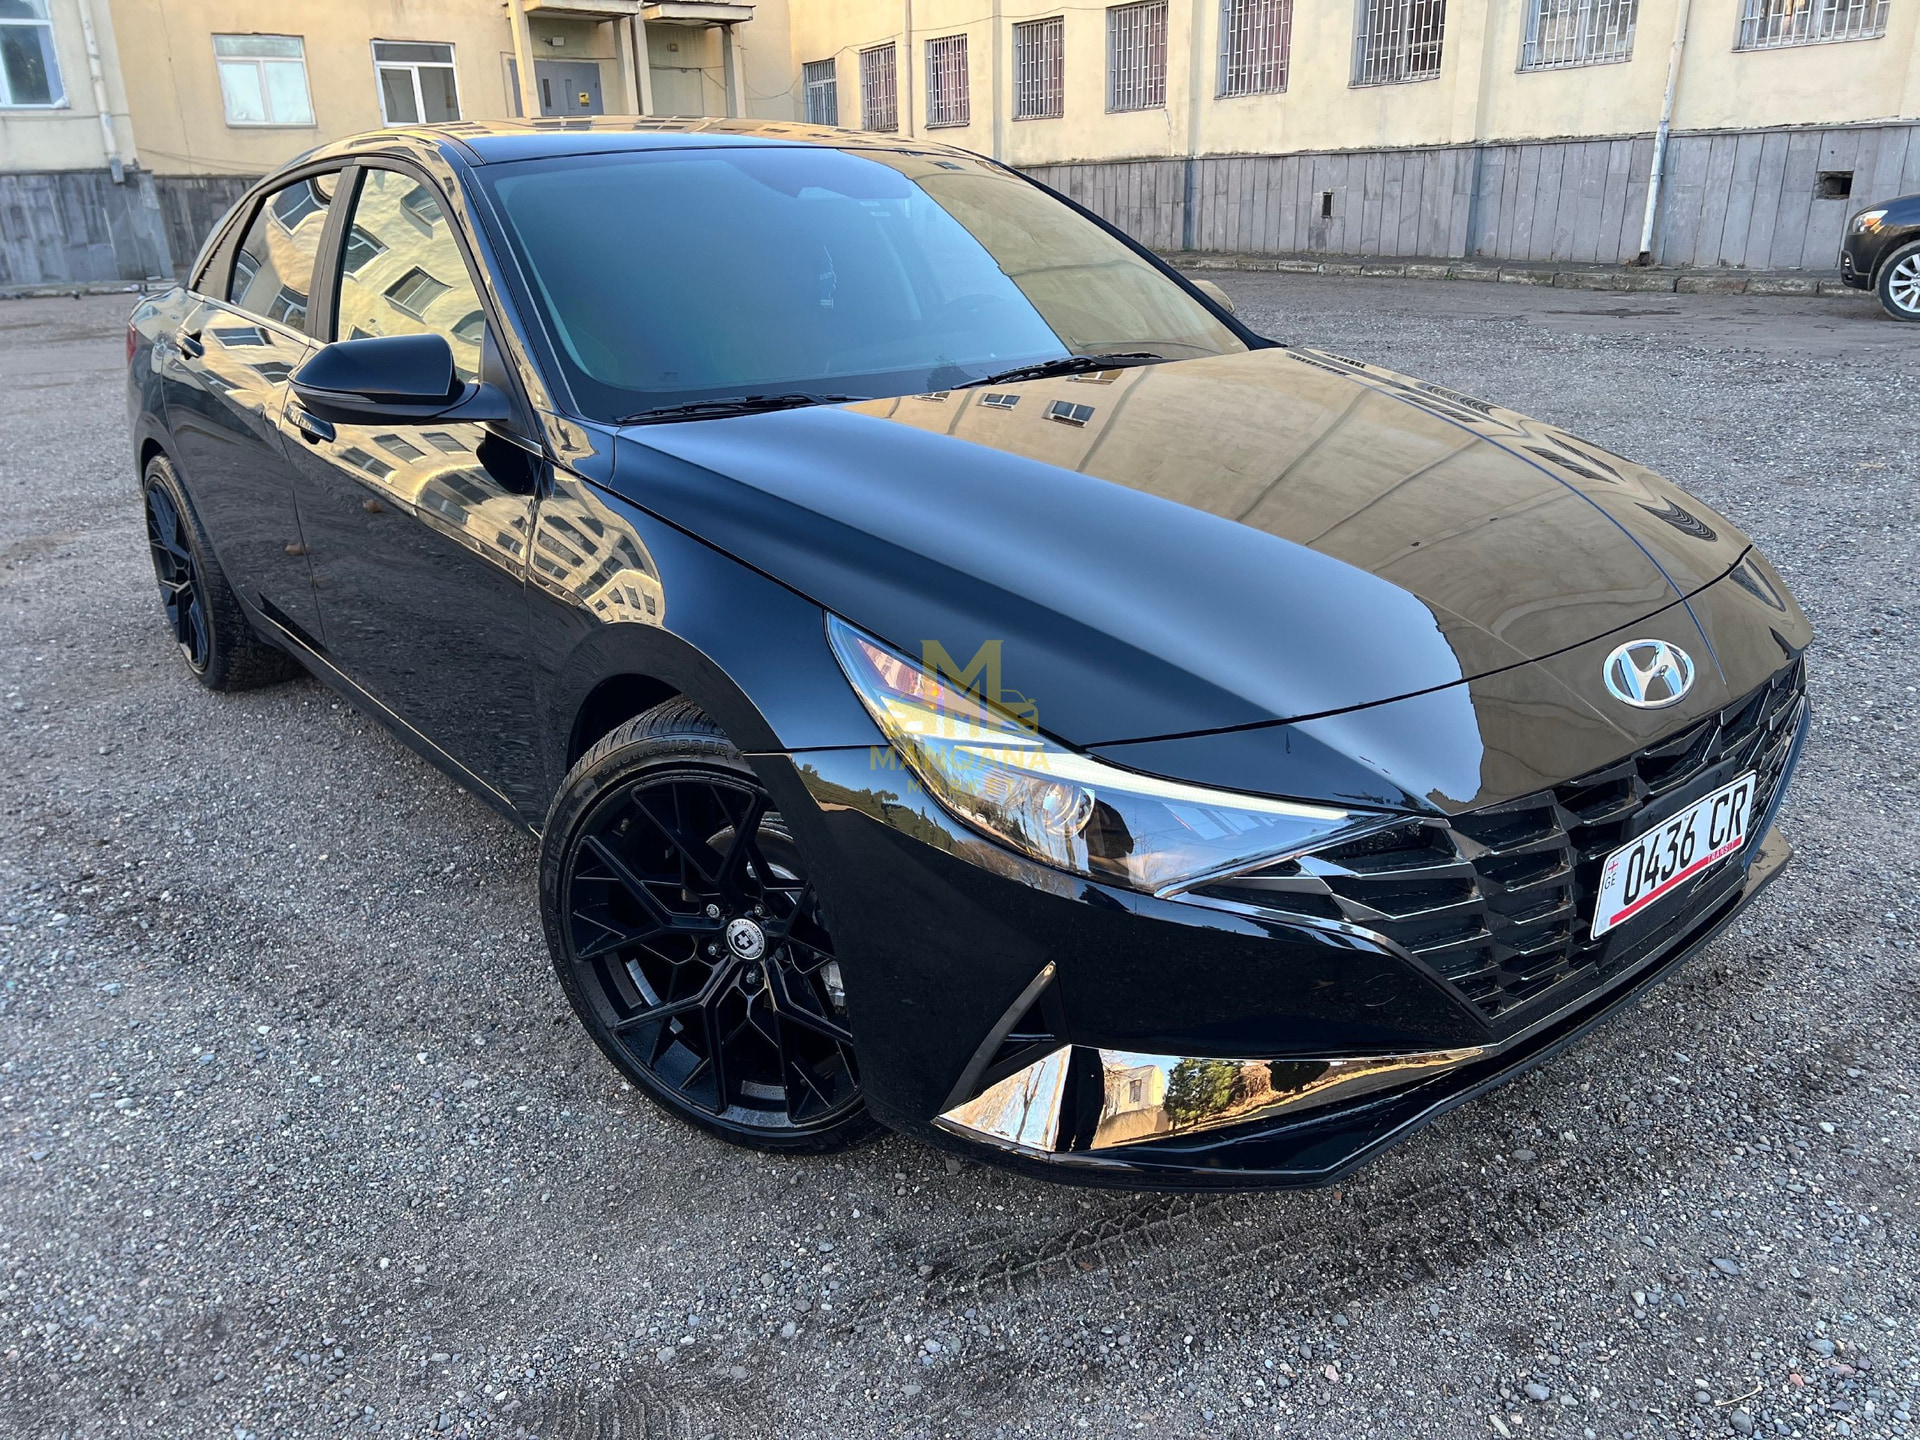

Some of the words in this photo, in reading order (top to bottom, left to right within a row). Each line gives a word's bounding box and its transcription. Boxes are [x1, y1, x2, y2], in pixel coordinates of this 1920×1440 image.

[1623, 810, 1698, 906] 0436
[1708, 783, 1748, 851] CR
[1707, 841, 1734, 864] TRANSIT
[1604, 872, 1617, 890] GE
